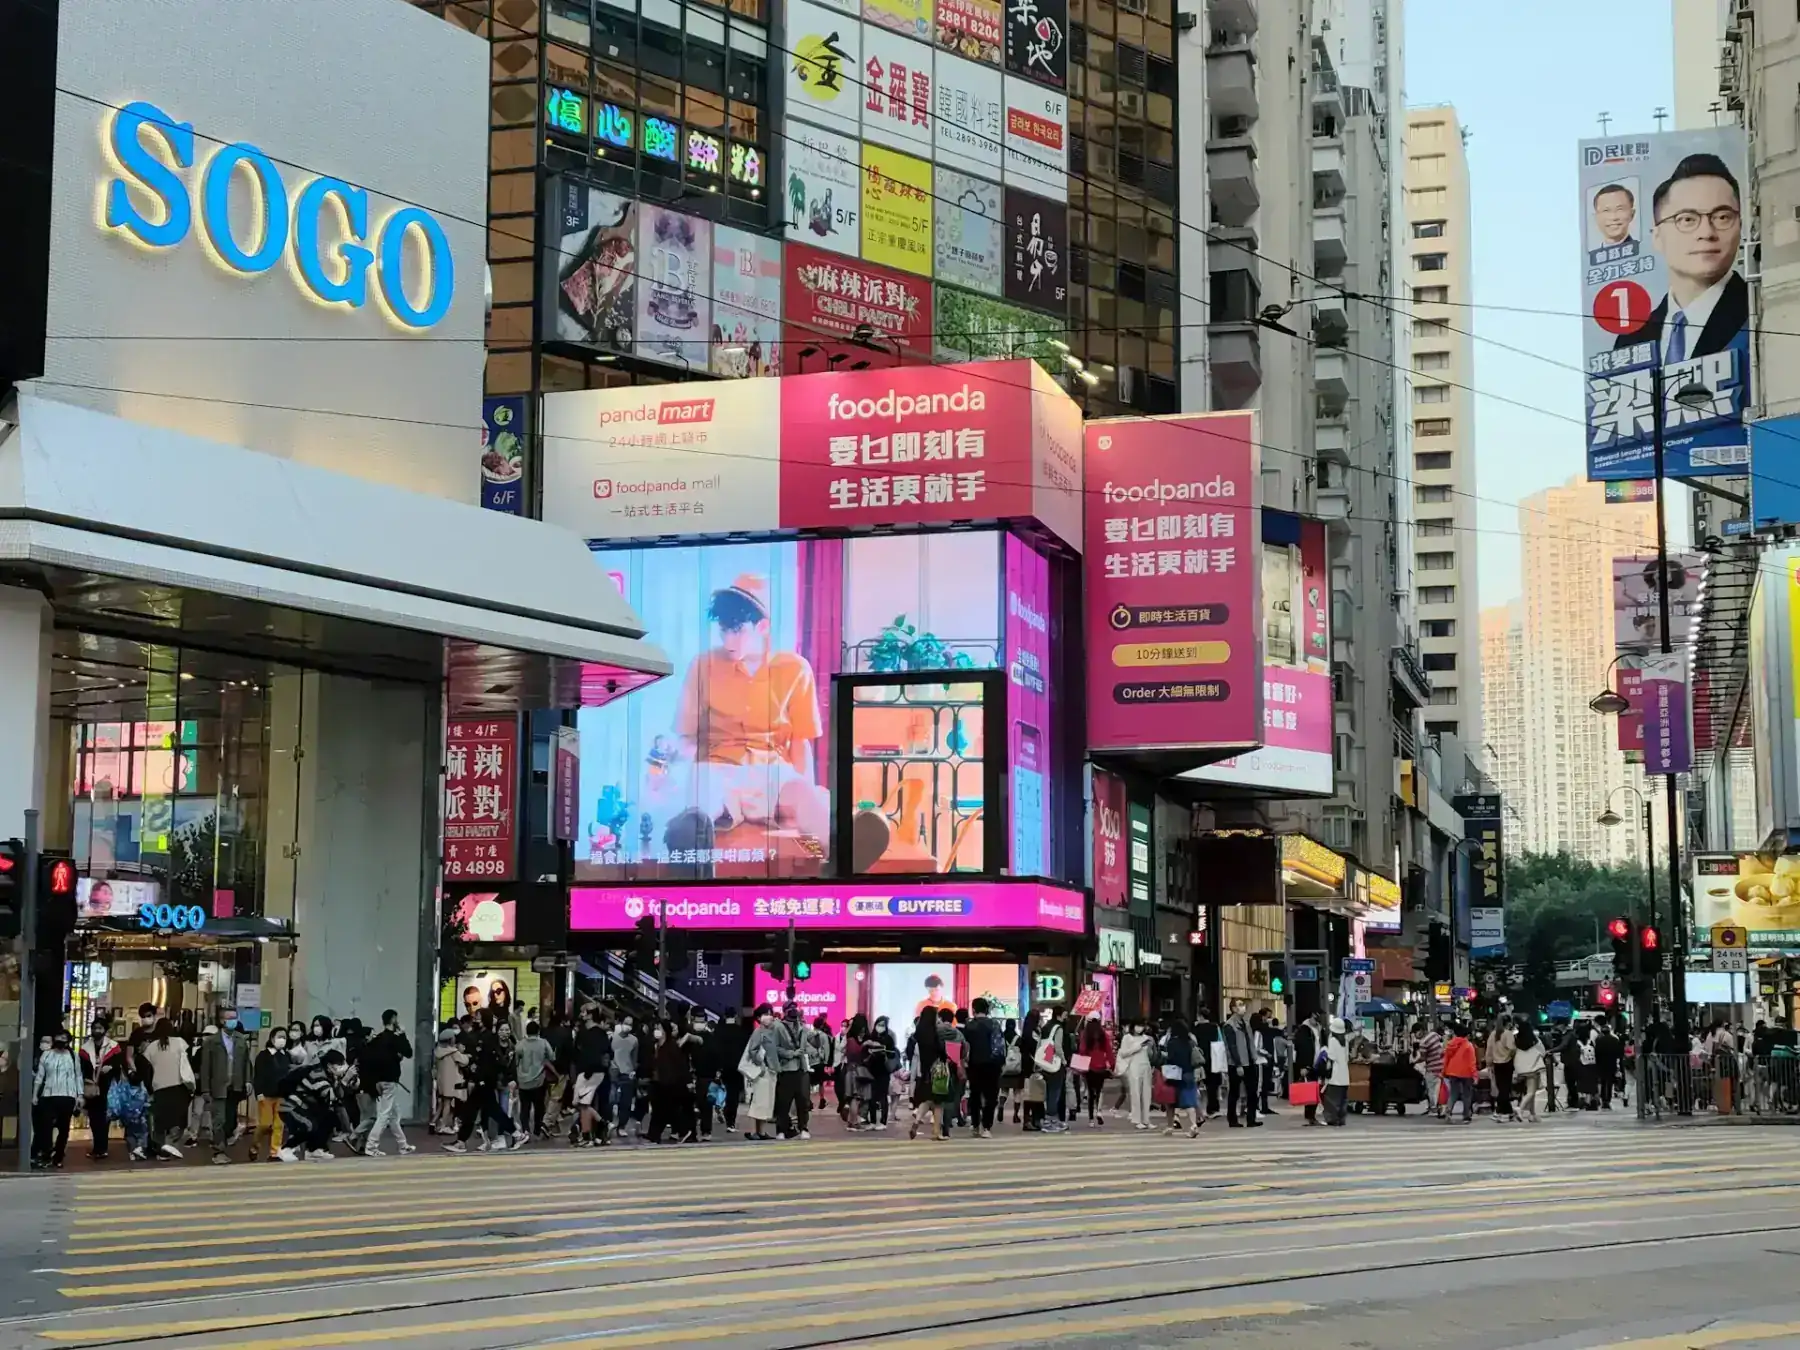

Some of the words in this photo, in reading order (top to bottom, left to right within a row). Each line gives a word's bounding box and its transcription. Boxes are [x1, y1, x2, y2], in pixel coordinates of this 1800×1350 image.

[938, 8, 967, 29] 2881
[970, 20, 1000, 40] 8204
[866, 55, 930, 130] 金羅寶
[939, 84, 1000, 137] 韓國料理
[1045, 100, 1062, 116] 6/F
[547, 87, 760, 186] 傷心酸辣粉
[105, 101, 454, 328] SOGO
[566, 215, 580, 228] 3F
[836, 208, 857, 226] 5/F
[911, 216, 929, 234] 5/F
[1587, 255, 1655, 286] 全力支持
[815, 264, 905, 311] 麻辣派對
[1055, 286, 1066, 301] 5F
[816, 295, 857, 320] CHILI
[858, 305, 905, 332] PARTY
[1611, 288, 1630, 328] 1
[599, 403, 657, 428] panda
[661, 400, 711, 421] mart
[827, 384, 986, 423] foodpanda
[828, 428, 986, 466] 要乜即刻有
[1594, 452, 1620, 464] Edward
[1620, 448, 1642, 461] Leung
[1664, 436, 1695, 448] Change
[492, 490, 516, 505] 6/F
[616, 478, 687, 496] foodpanda
[691, 475, 721, 490] mall
[828, 470, 986, 510] 生活更就手
[1103, 475, 1236, 507] foodpanda
[610, 500, 705, 518] 一站式生活平台
[1104, 512, 1236, 544] 要乜即刻有
[1104, 547, 1236, 578] 生活更就手
[1138, 608, 1211, 624] 即時生活百貨
[1135, 646, 1198, 661] 10分鐘送到
[1122, 686, 1156, 699] Order
[1158, 684, 1220, 699] 大細無限制
[475, 724, 498, 737] 4/F
[465, 860, 505, 875] 4898
[139, 903, 206, 930] SOGO
[897, 899, 963, 913] BUYFREE
[1720, 960, 1741, 969] 全日
[720, 973, 735, 986] 3F
